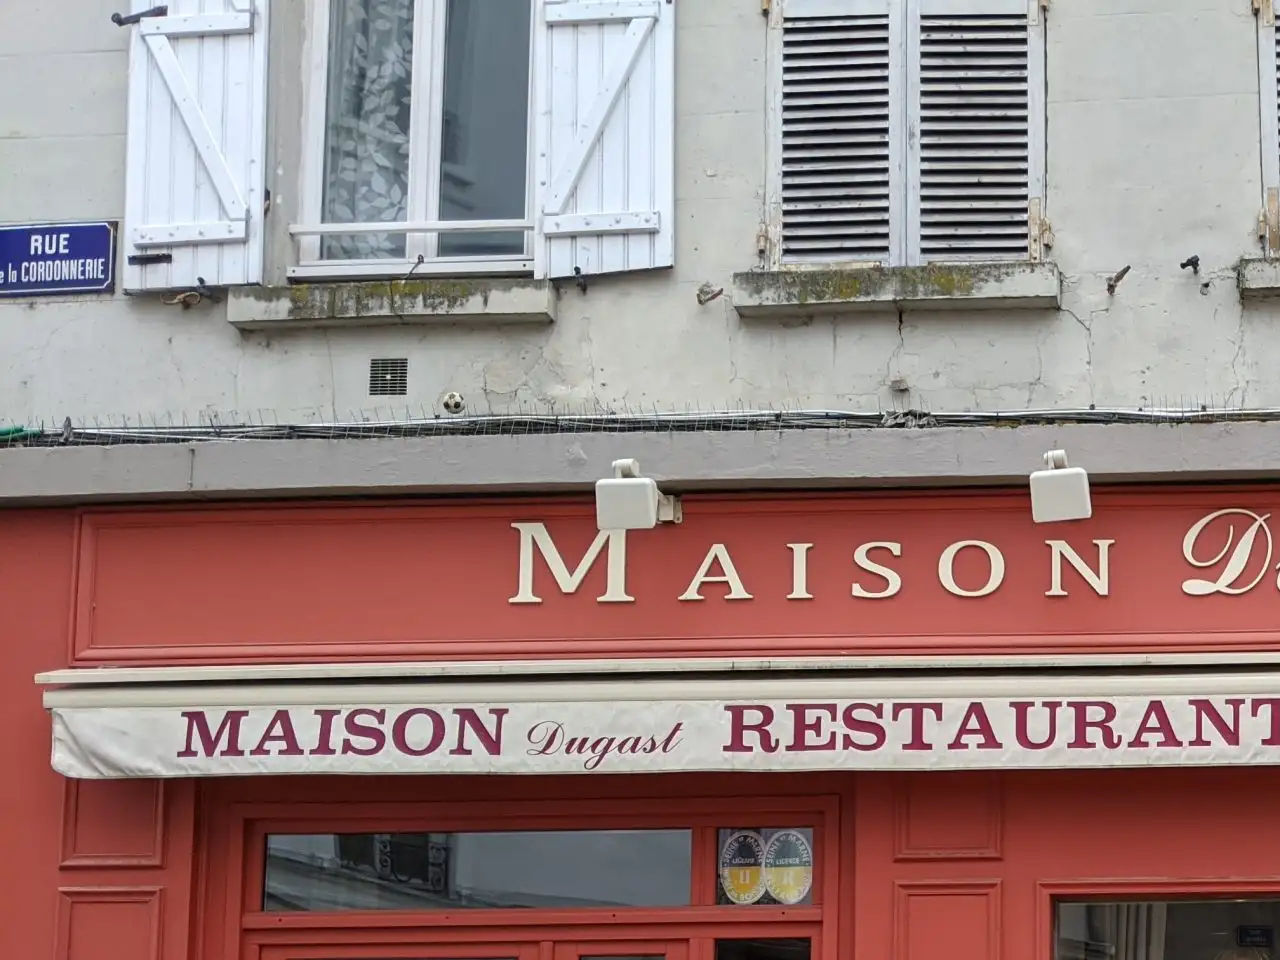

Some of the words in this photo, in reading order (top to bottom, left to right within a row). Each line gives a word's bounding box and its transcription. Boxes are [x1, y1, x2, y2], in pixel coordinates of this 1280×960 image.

[30, 233, 70, 255] RUE
[8, 263, 17, 283] la
[21, 258, 105, 282] CORDONNERIE
[508, 522, 1115, 603] MAISON
[177, 707, 509, 758] MAISON
[526, 720, 685, 770] Dugast
